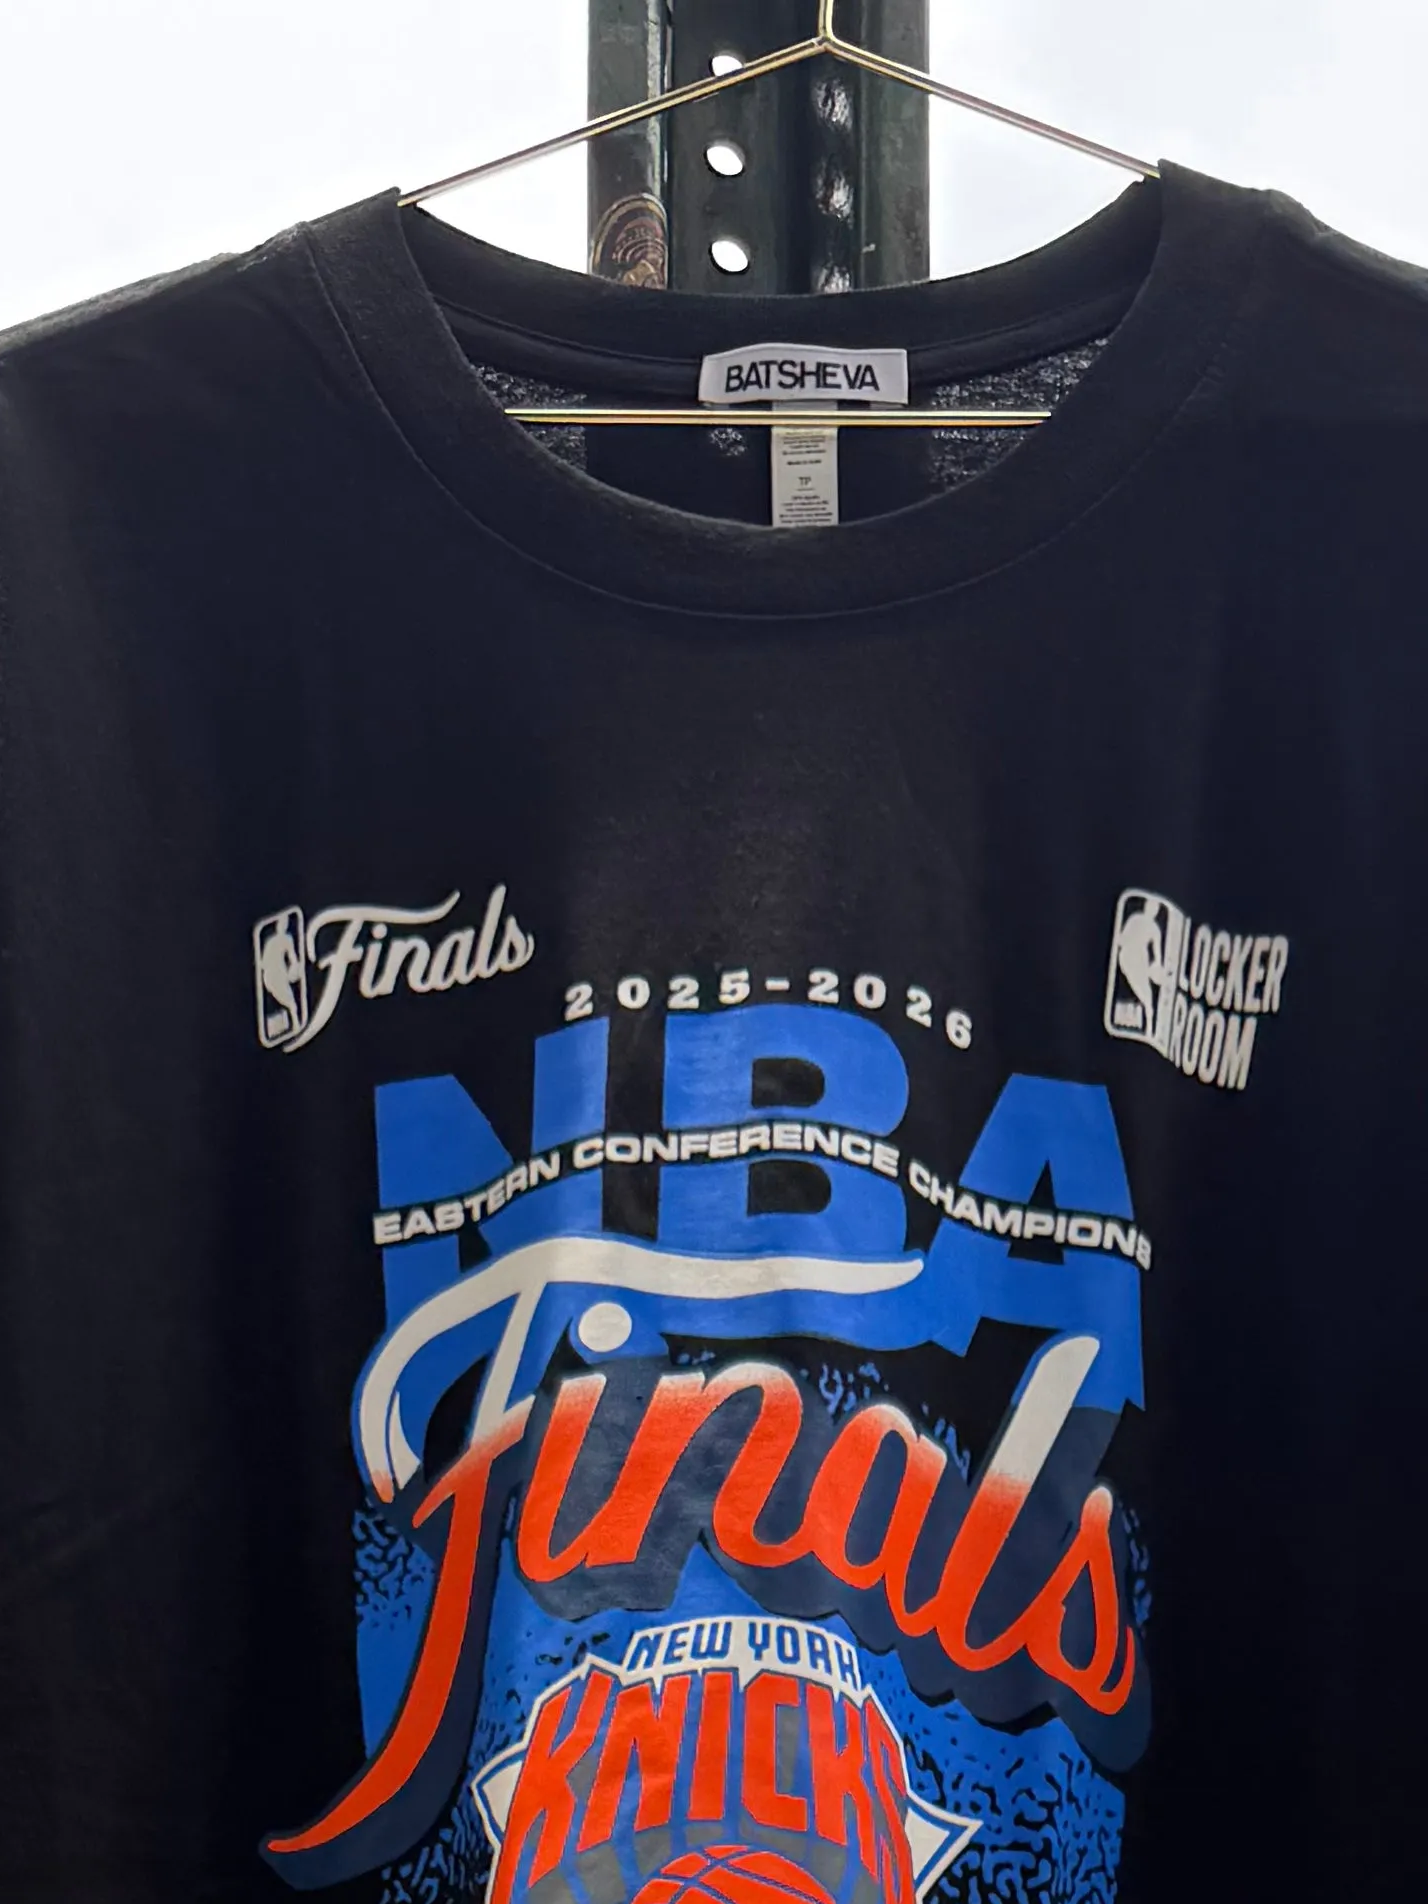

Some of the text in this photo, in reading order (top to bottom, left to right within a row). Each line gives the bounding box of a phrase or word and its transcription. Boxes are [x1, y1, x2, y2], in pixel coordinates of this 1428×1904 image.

[725, 360, 880, 393] BATSHEVA
[282, 883, 535, 1054] Finals
[564, 966, 973, 1050] 2025-2026
[1178, 916, 1289, 1014] LOCKER
[1168, 992, 1258, 1091] ROOM
[373, 1122, 1153, 1272] EASTERN CONFERENCE CHAMPIONS
[375, 1003, 1147, 1412] NBA
[265, 1236, 1137, 1853] Finals
[625, 1620, 863, 1689] NEW YORK
